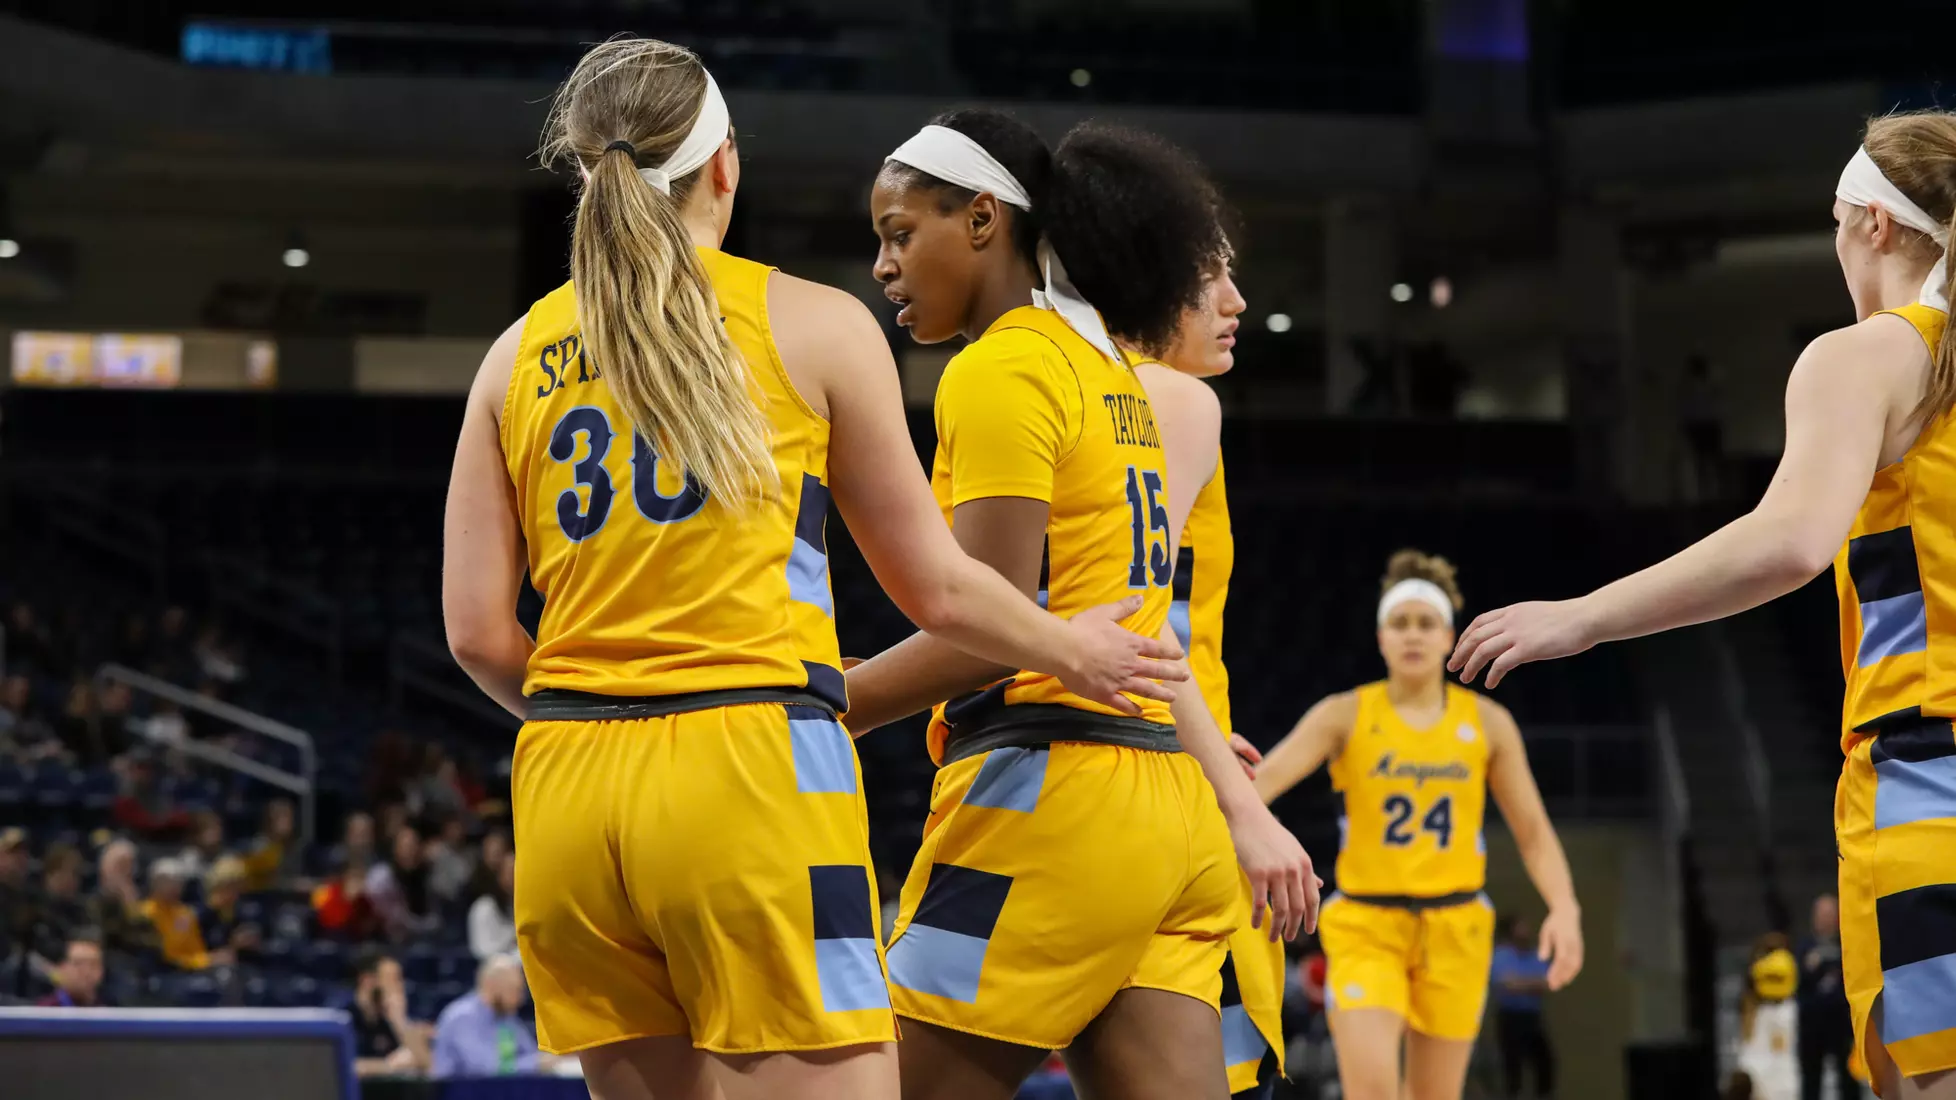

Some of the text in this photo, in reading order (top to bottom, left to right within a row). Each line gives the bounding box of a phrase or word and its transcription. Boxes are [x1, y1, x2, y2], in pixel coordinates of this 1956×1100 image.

[1102, 393, 1160, 449] TAYLOR
[1125, 464, 1172, 588] 15
[1382, 793, 1454, 850] 24
